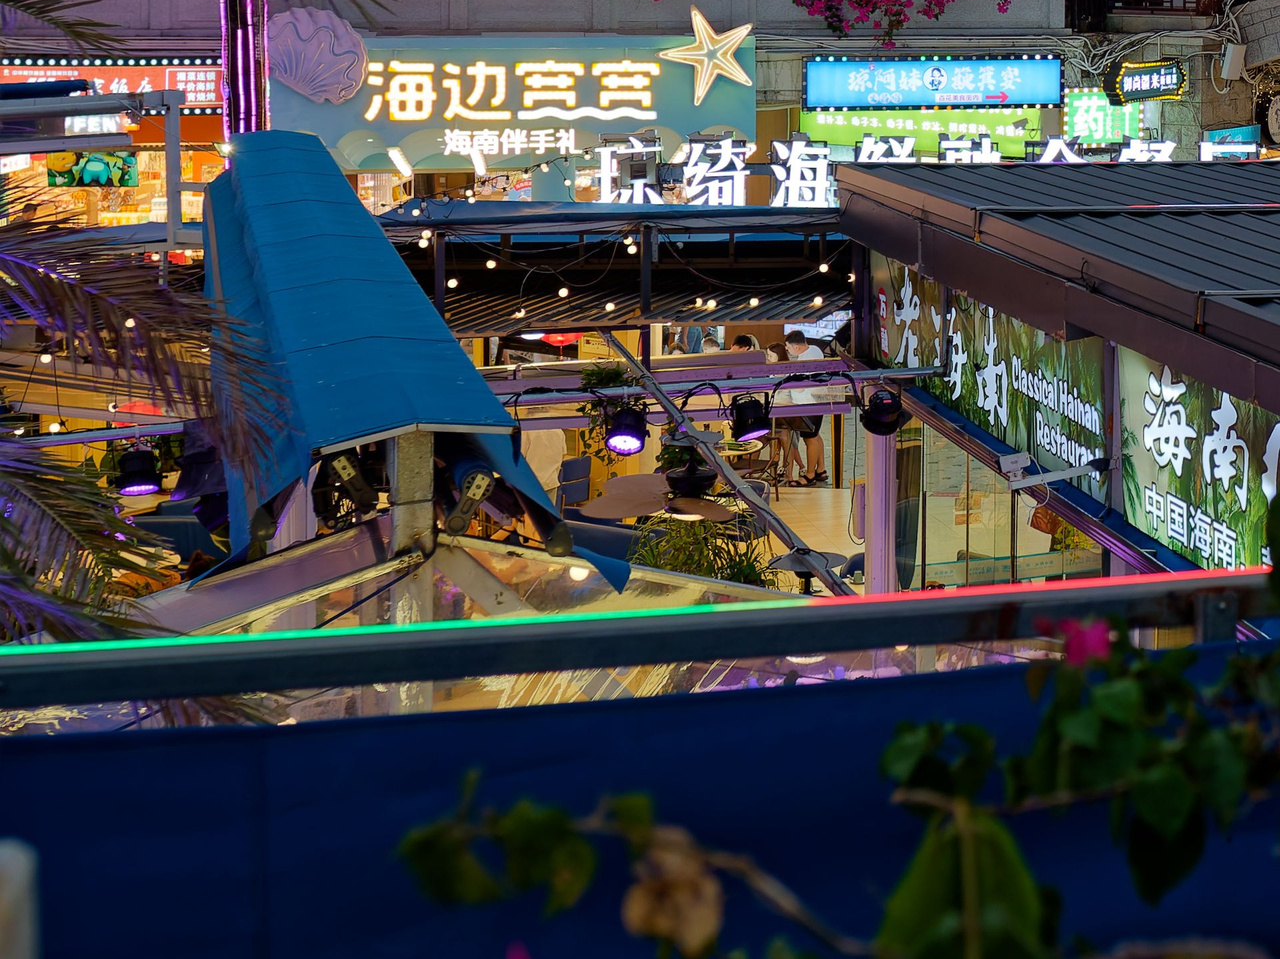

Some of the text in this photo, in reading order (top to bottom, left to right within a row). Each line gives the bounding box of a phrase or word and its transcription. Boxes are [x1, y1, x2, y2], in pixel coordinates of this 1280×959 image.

[1073, 95, 1106, 140] 药
[444, 128, 583, 156] 海南伴手礼
[1012, 355, 1100, 435] Classical Hainan
